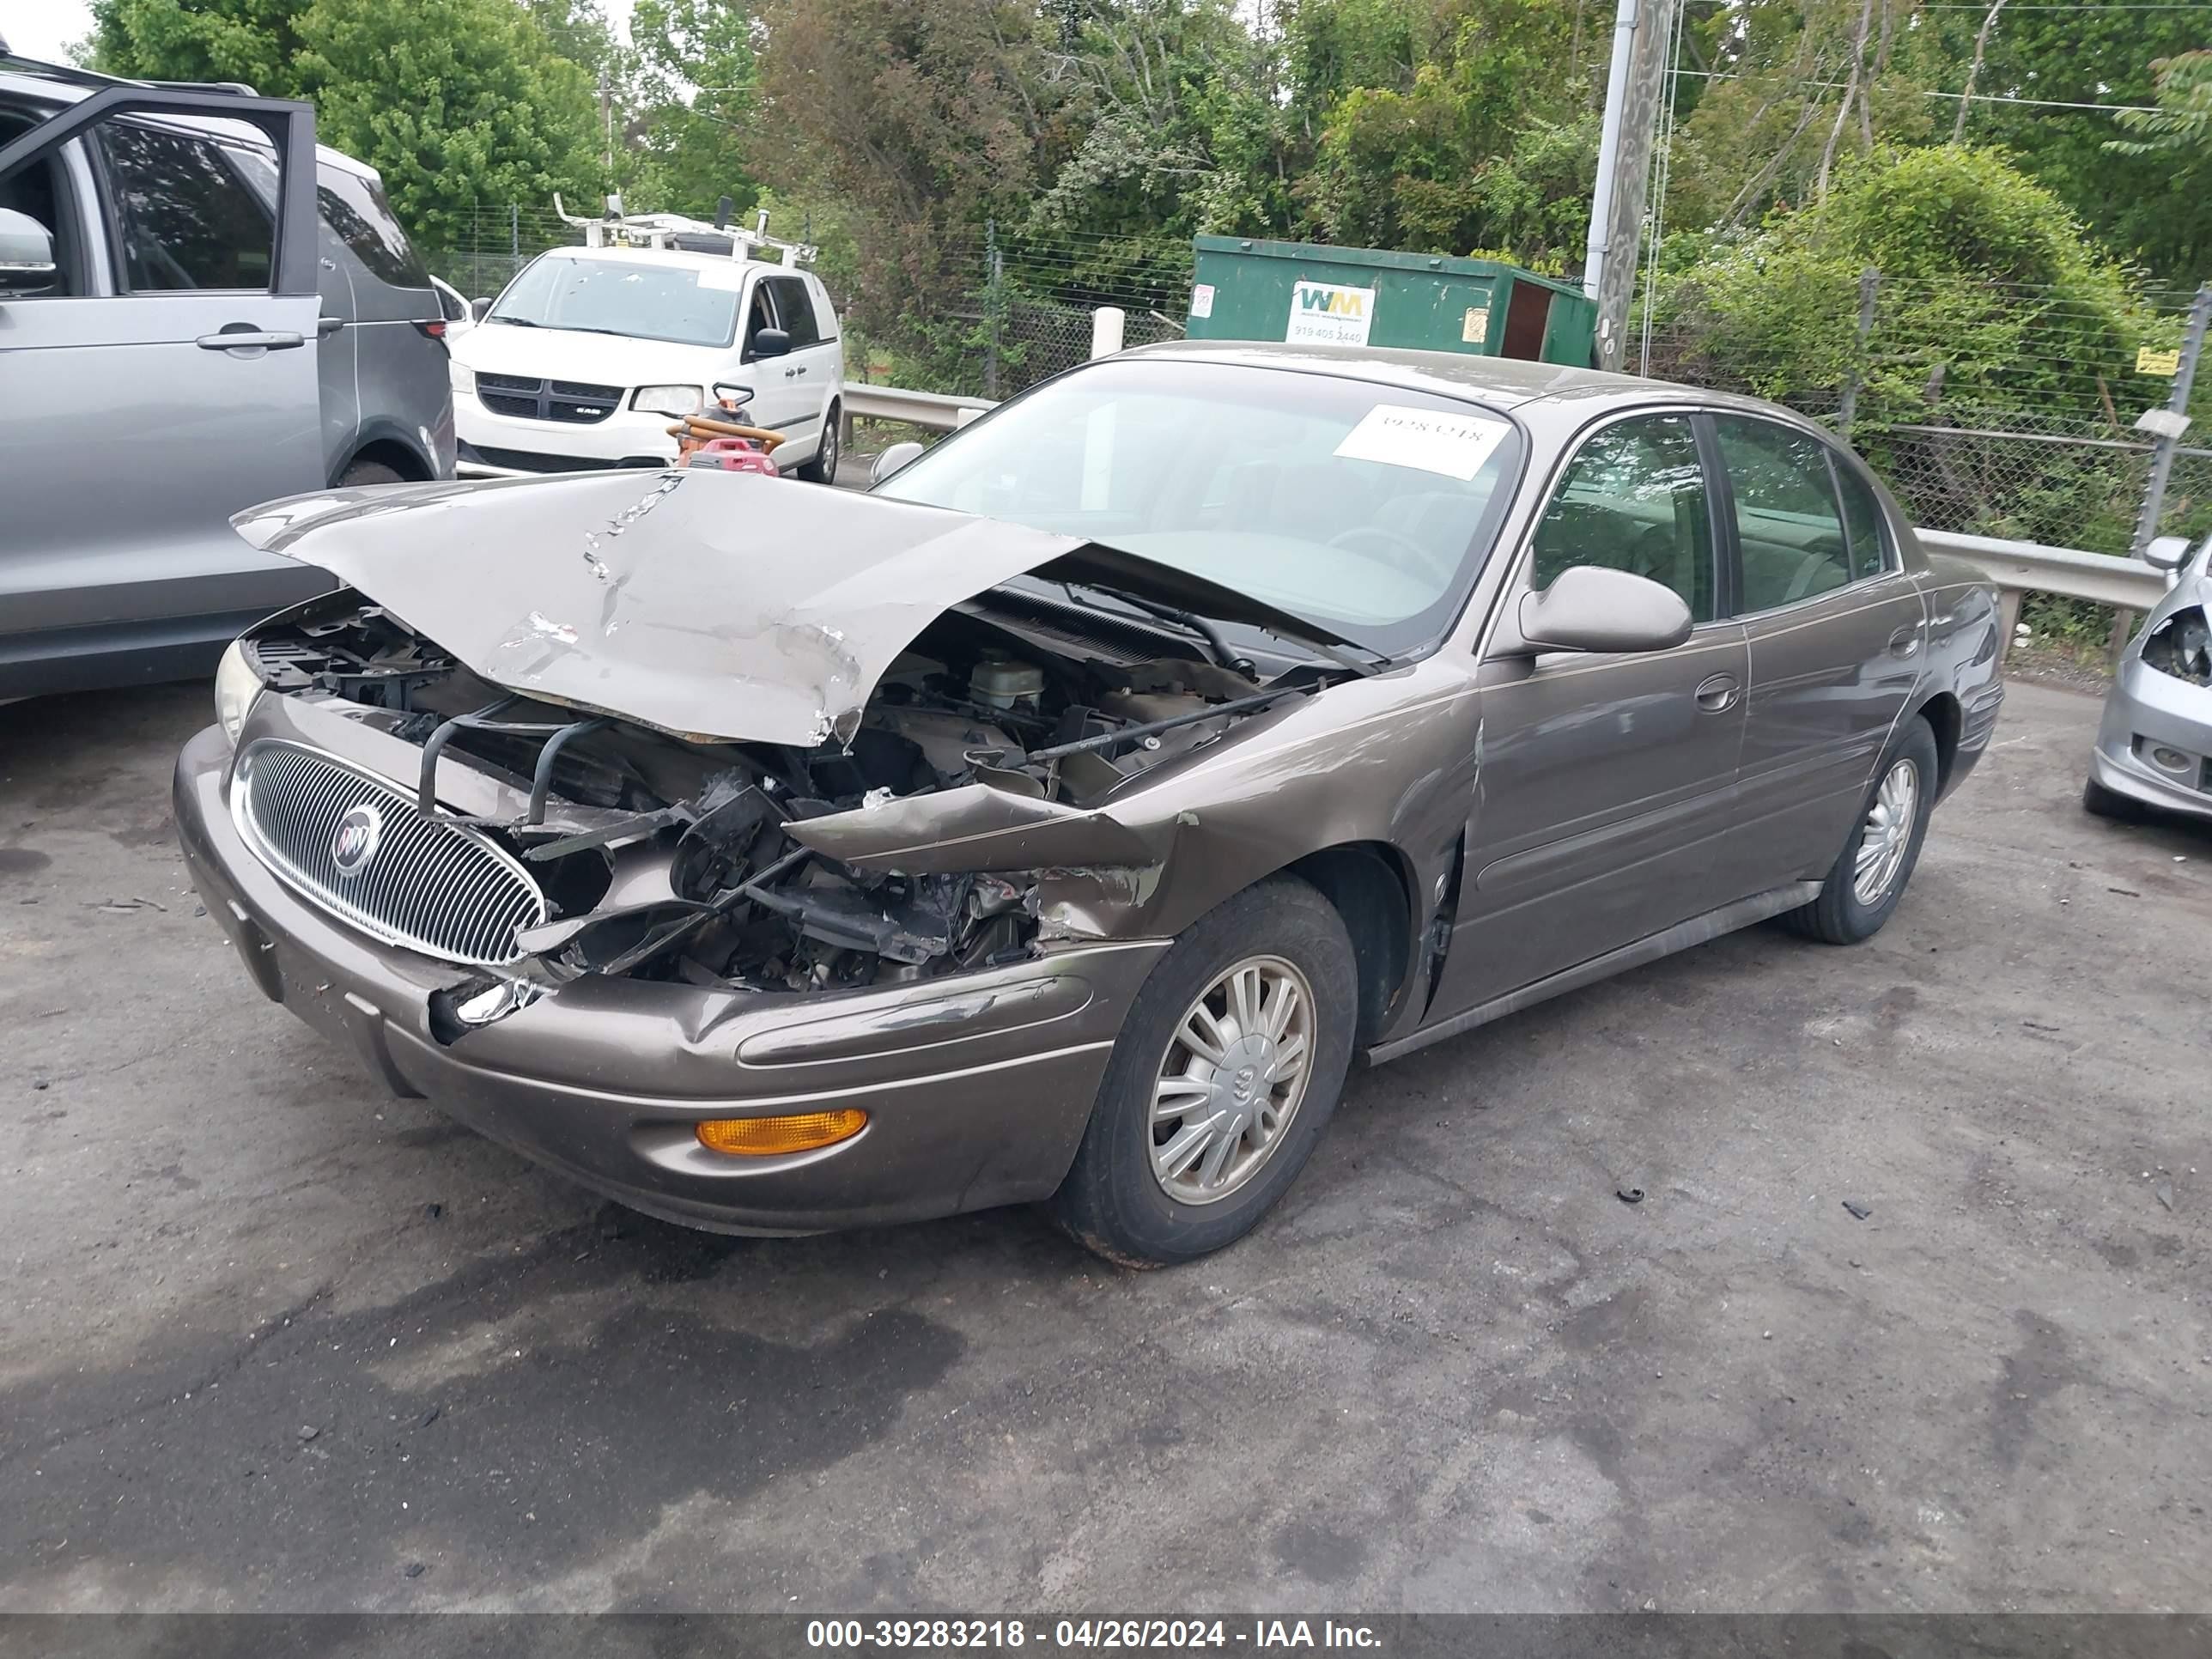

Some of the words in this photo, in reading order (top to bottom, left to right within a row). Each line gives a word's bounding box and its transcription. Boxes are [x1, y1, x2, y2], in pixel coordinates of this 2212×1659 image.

[1301, 288, 1363, 317] WM
[1295, 325, 1314, 337] 919
[1316, 329, 1334, 339] 405
[1336, 330, 1362, 343] 2440
